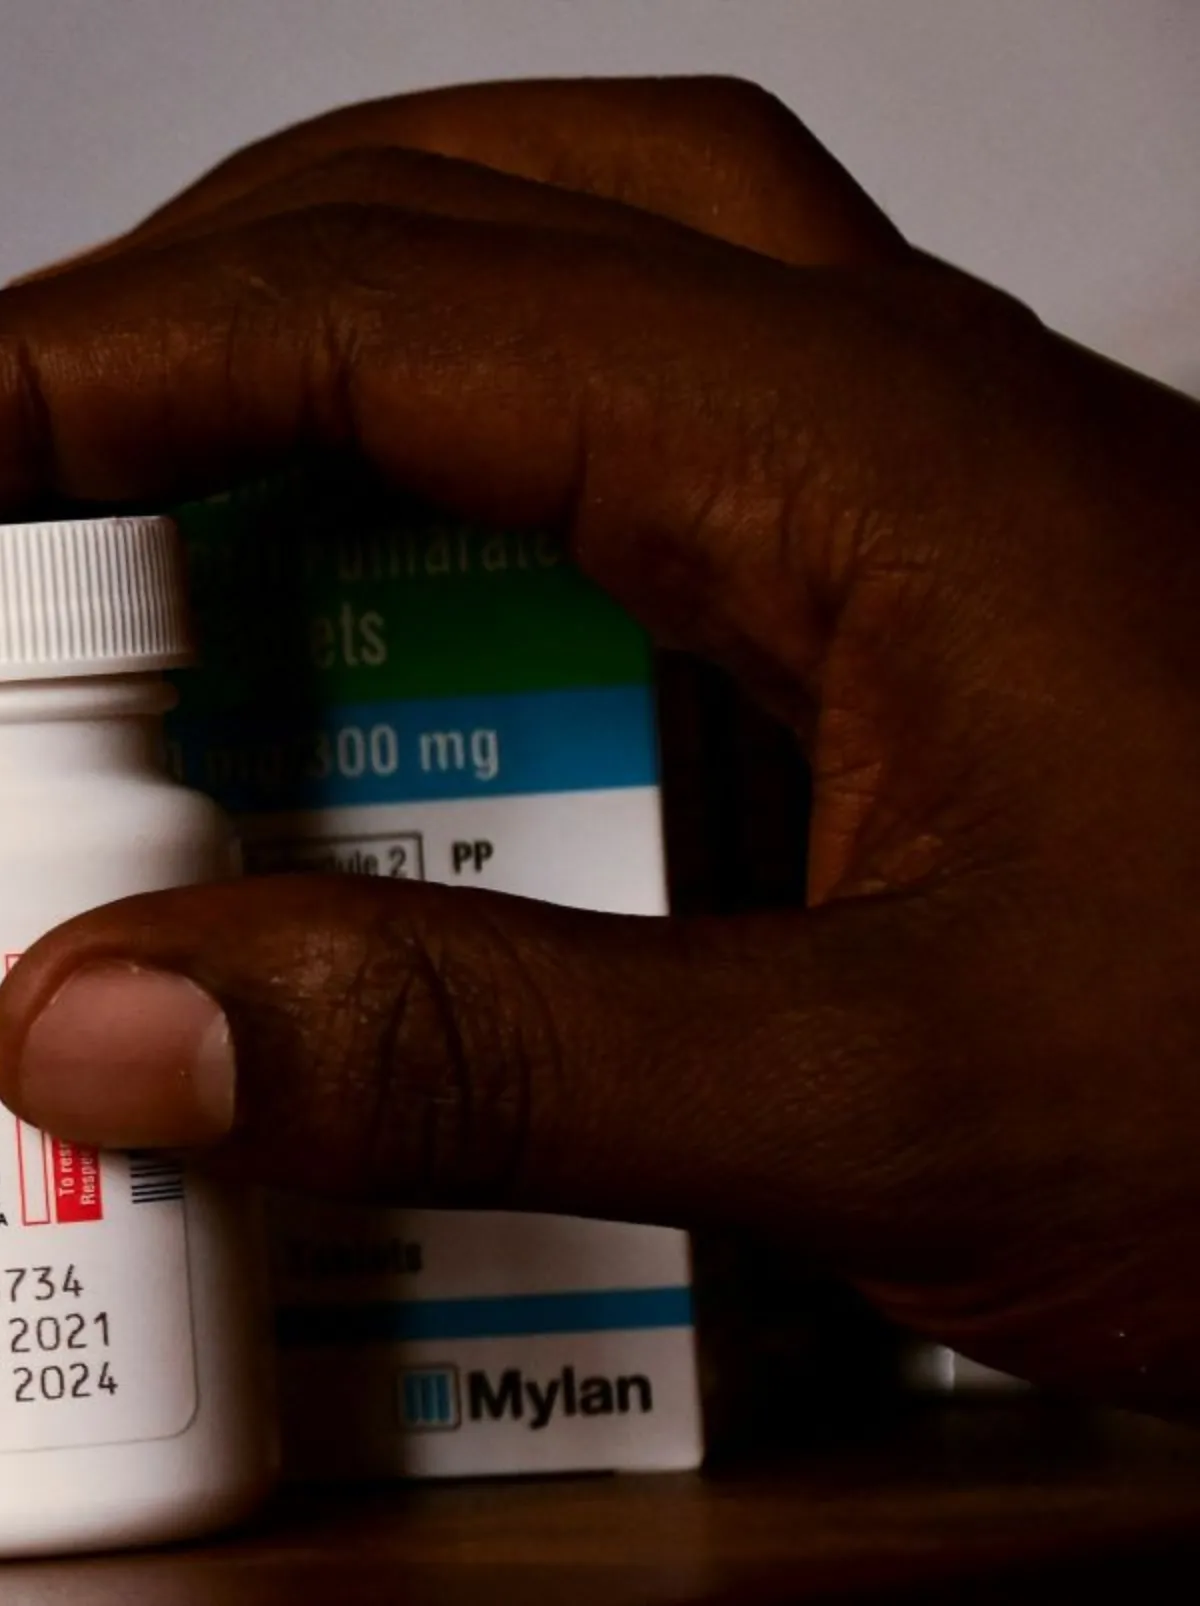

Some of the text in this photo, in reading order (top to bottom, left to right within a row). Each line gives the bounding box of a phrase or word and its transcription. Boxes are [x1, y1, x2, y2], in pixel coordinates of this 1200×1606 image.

[420, 727, 500, 781] mg
[452, 840, 493, 875] PP
[58, 1177, 74, 1197] To
[14, 1361, 118, 1403] 2024
[468, 1366, 652, 1430] Mylan
